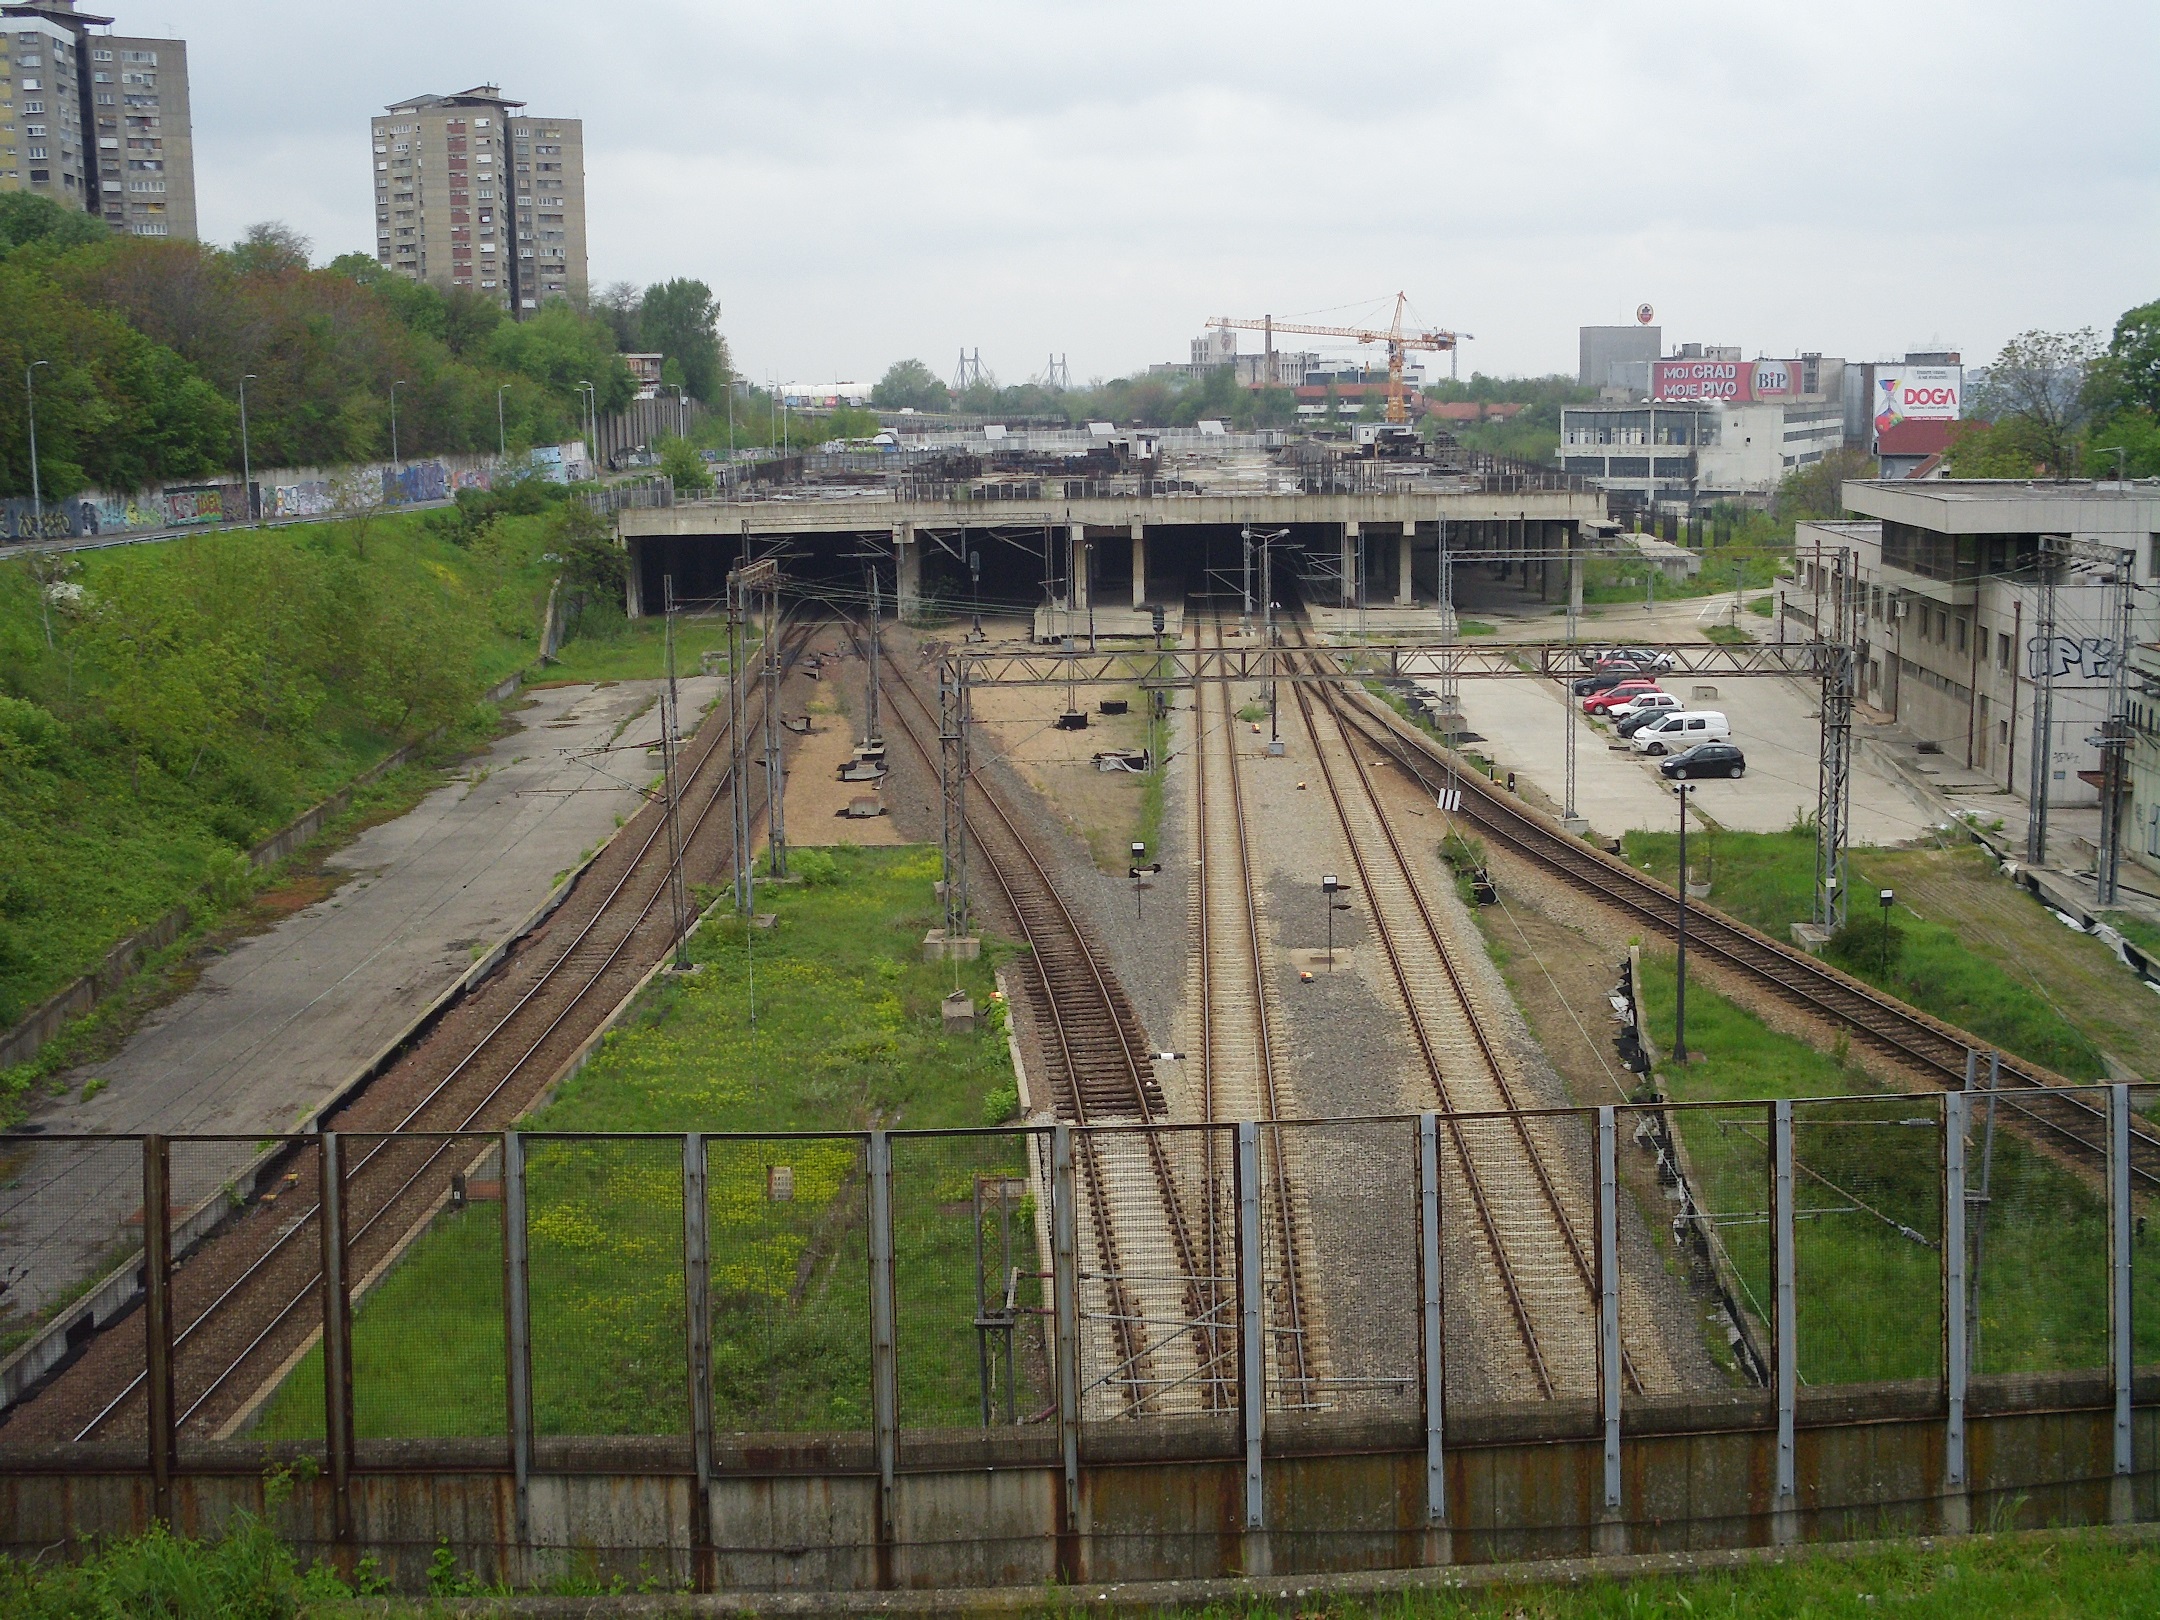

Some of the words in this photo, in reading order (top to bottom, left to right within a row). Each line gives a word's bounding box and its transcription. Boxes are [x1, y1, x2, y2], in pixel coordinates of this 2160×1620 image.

[1663, 367, 1688, 379] MOJ
[1692, 365, 1736, 379] GRAD
[1663, 384, 1698, 396] MOJE
[1701, 381, 1737, 396] PIVO
[1904, 388, 1957, 405] DOGA
